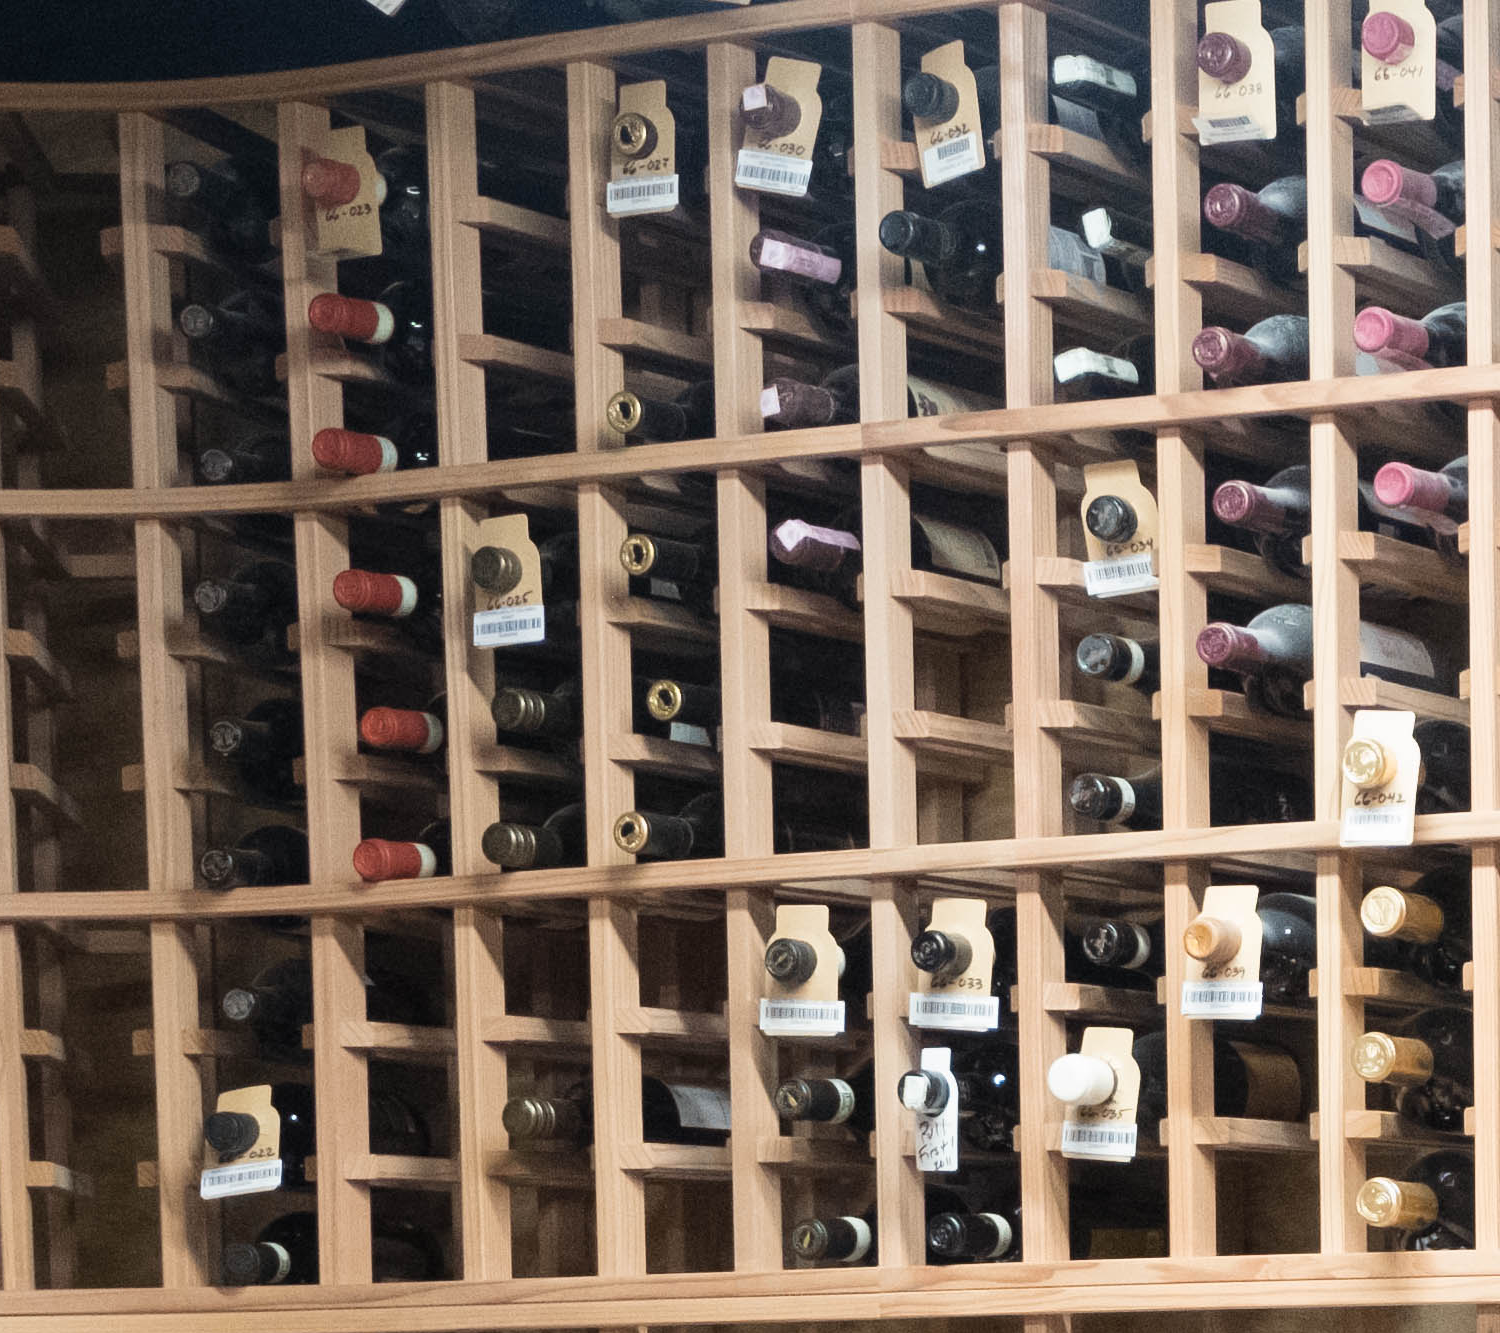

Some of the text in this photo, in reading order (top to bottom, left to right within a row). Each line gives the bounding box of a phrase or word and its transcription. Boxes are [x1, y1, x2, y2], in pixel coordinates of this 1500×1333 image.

[1374, 66, 1422, 81] 66-041
[1215, 85, 1262, 99] 66-038
[325, 205, 372, 222] 66-023
[1355, 791, 1406, 806] 66-042
